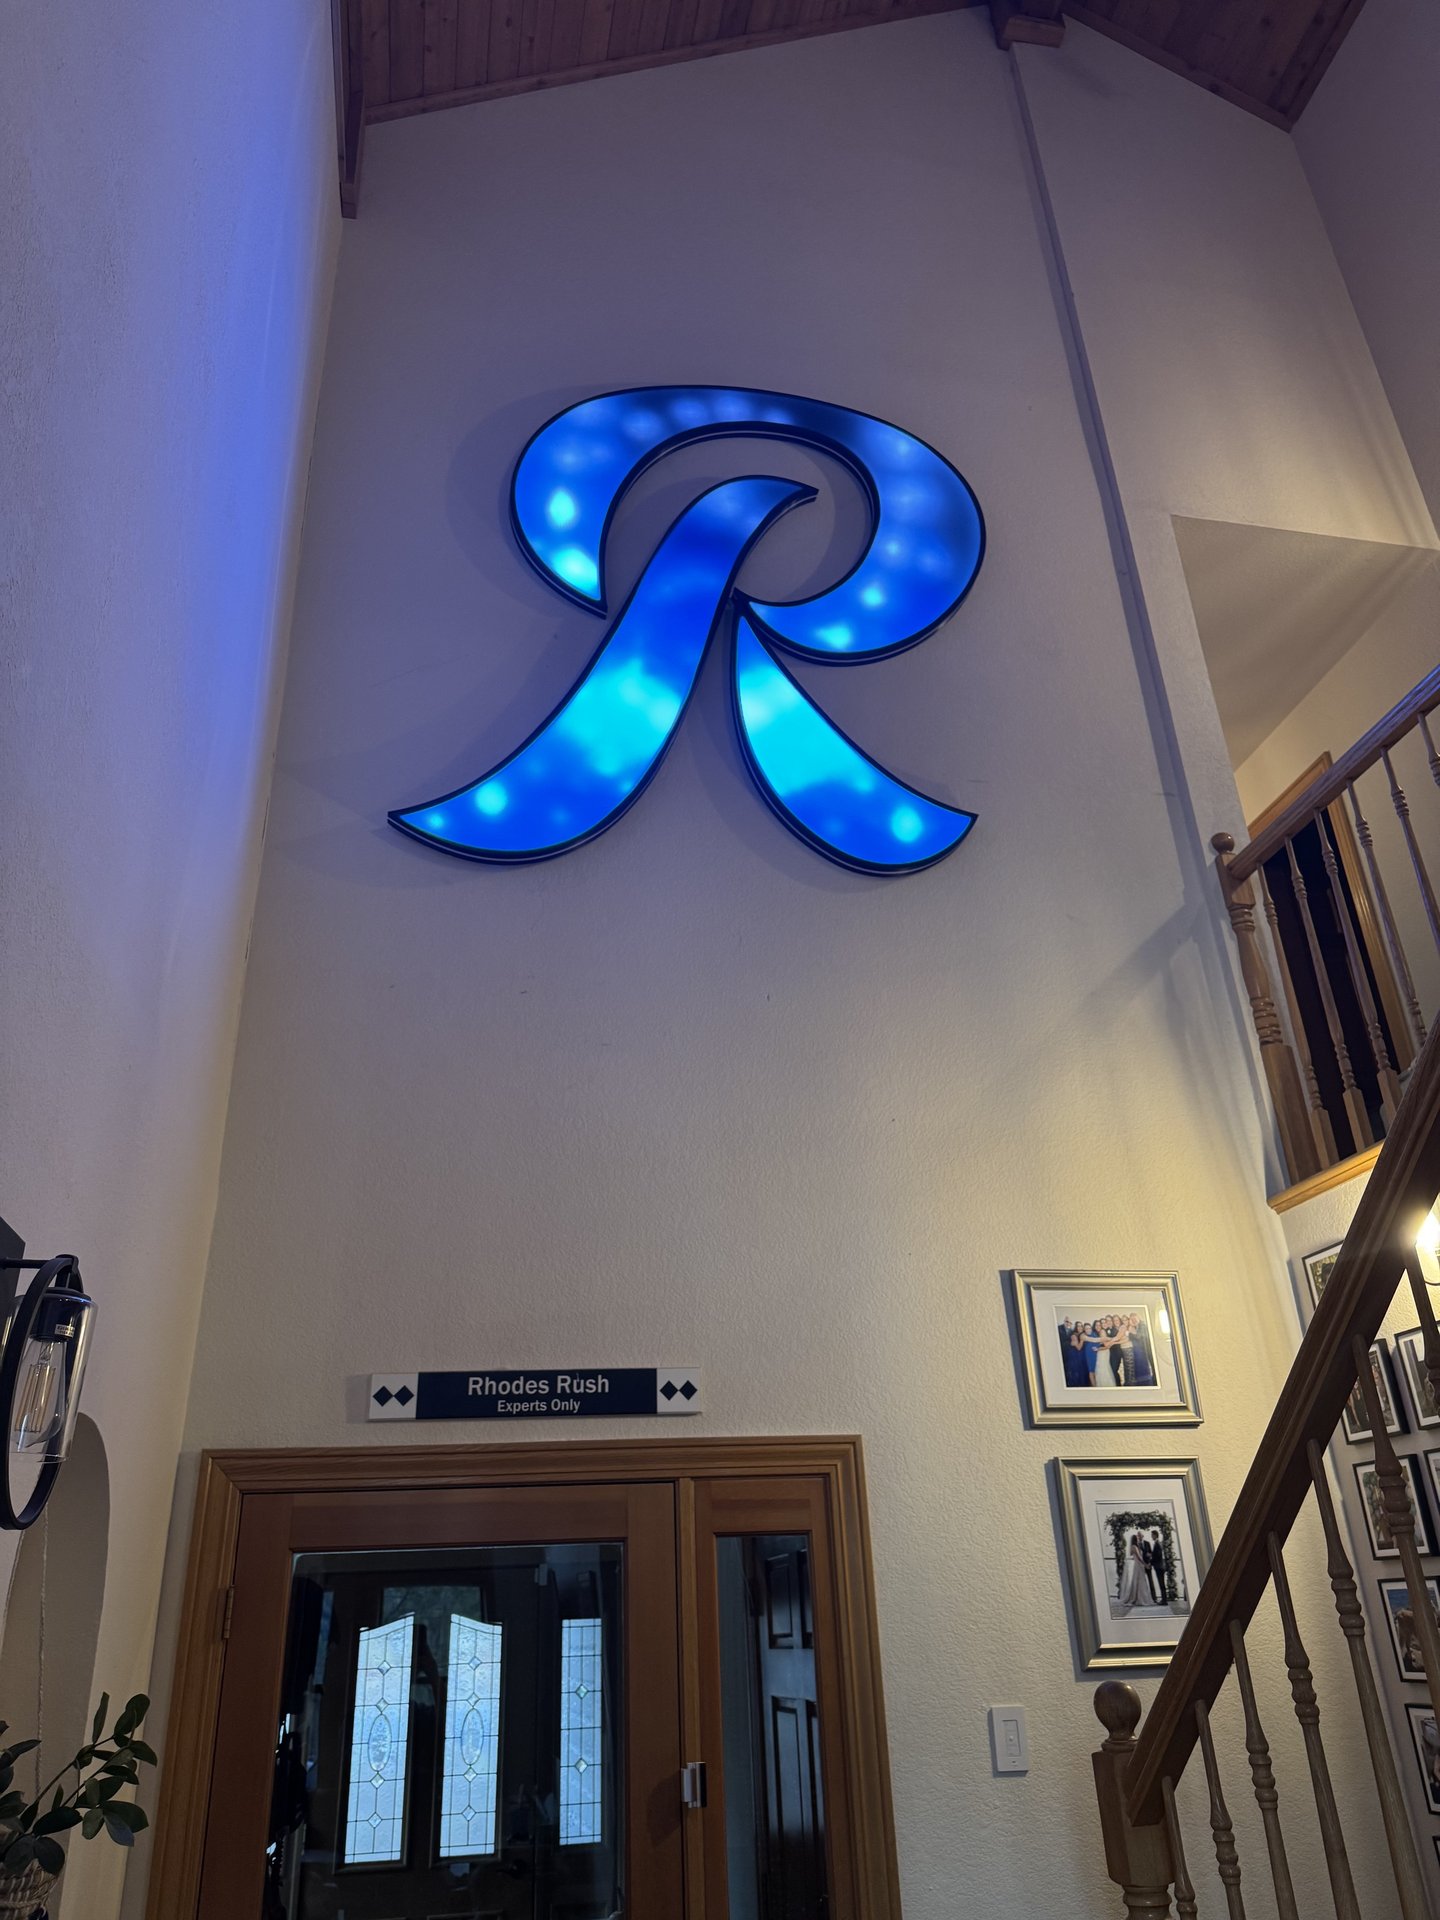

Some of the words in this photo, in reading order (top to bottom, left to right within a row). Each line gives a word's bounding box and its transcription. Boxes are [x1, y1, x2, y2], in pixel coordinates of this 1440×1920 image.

[387, 384, 986, 877] R
[468, 1376, 550, 1395] Rhodes
[556, 1375, 610, 1394] Rush
[497, 1400, 548, 1414] Experts
[551, 1398, 581, 1413] Only
